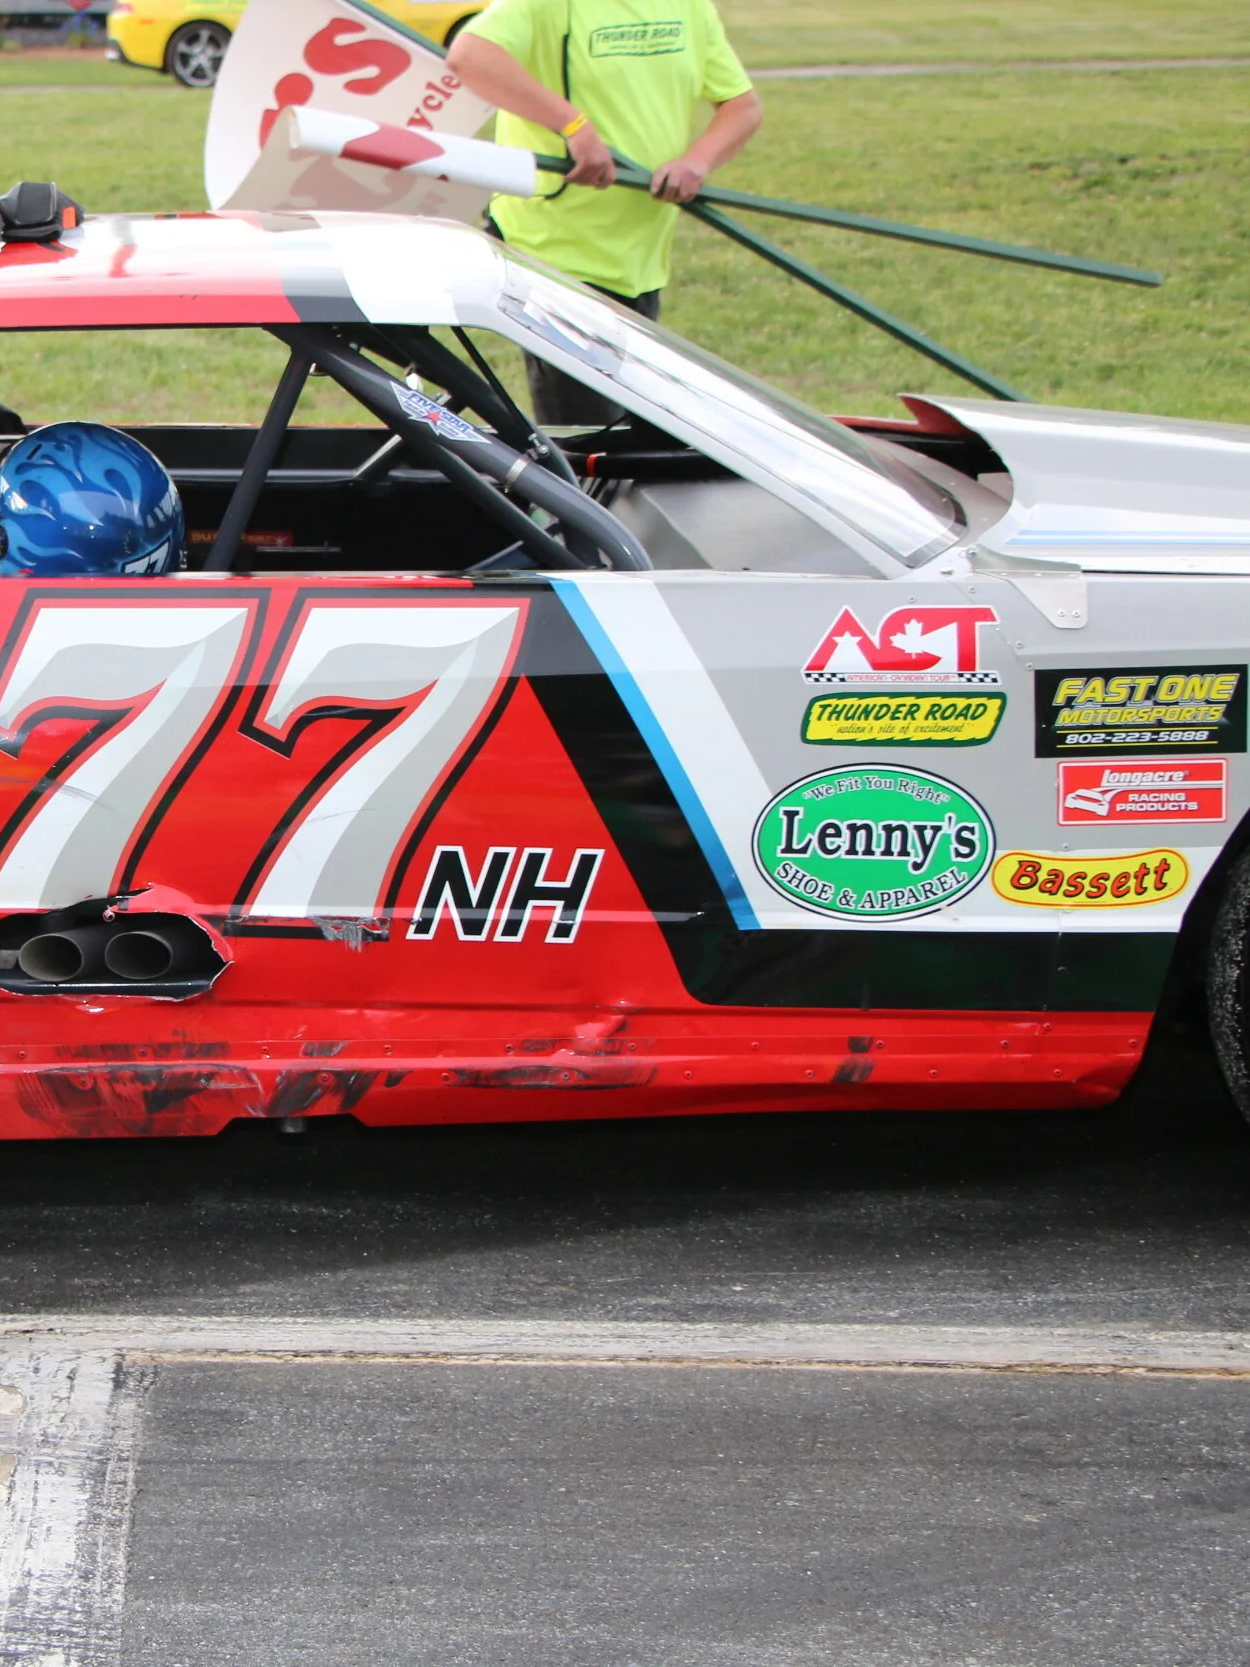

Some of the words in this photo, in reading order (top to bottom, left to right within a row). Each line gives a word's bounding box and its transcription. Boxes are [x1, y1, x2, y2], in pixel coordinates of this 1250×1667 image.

[802, 606, 1001, 673] ACT
[1052, 677, 1158, 706] FAST
[1155, 674, 1239, 702] ONE
[816, 703, 921, 722] THUNDER
[924, 703, 989, 722] ROAD
[1055, 704, 1226, 726] MOTORSPORTS
[1065, 731, 1209, 745] 802-223-5888
[837, 777, 861, 794] Fit
[865, 775, 893, 790] You
[1128, 792, 1186, 803] RACING
[1116, 801, 1199, 812] PRODUCTS
[778, 808, 979, 873] Lenny's
[776, 861, 834, 903] SHOE
[838, 890, 856, 908] &
[860, 868, 969, 911] APPAREL
[1009, 857, 1172, 899] Bassett
[405, 845, 606, 944] NH
